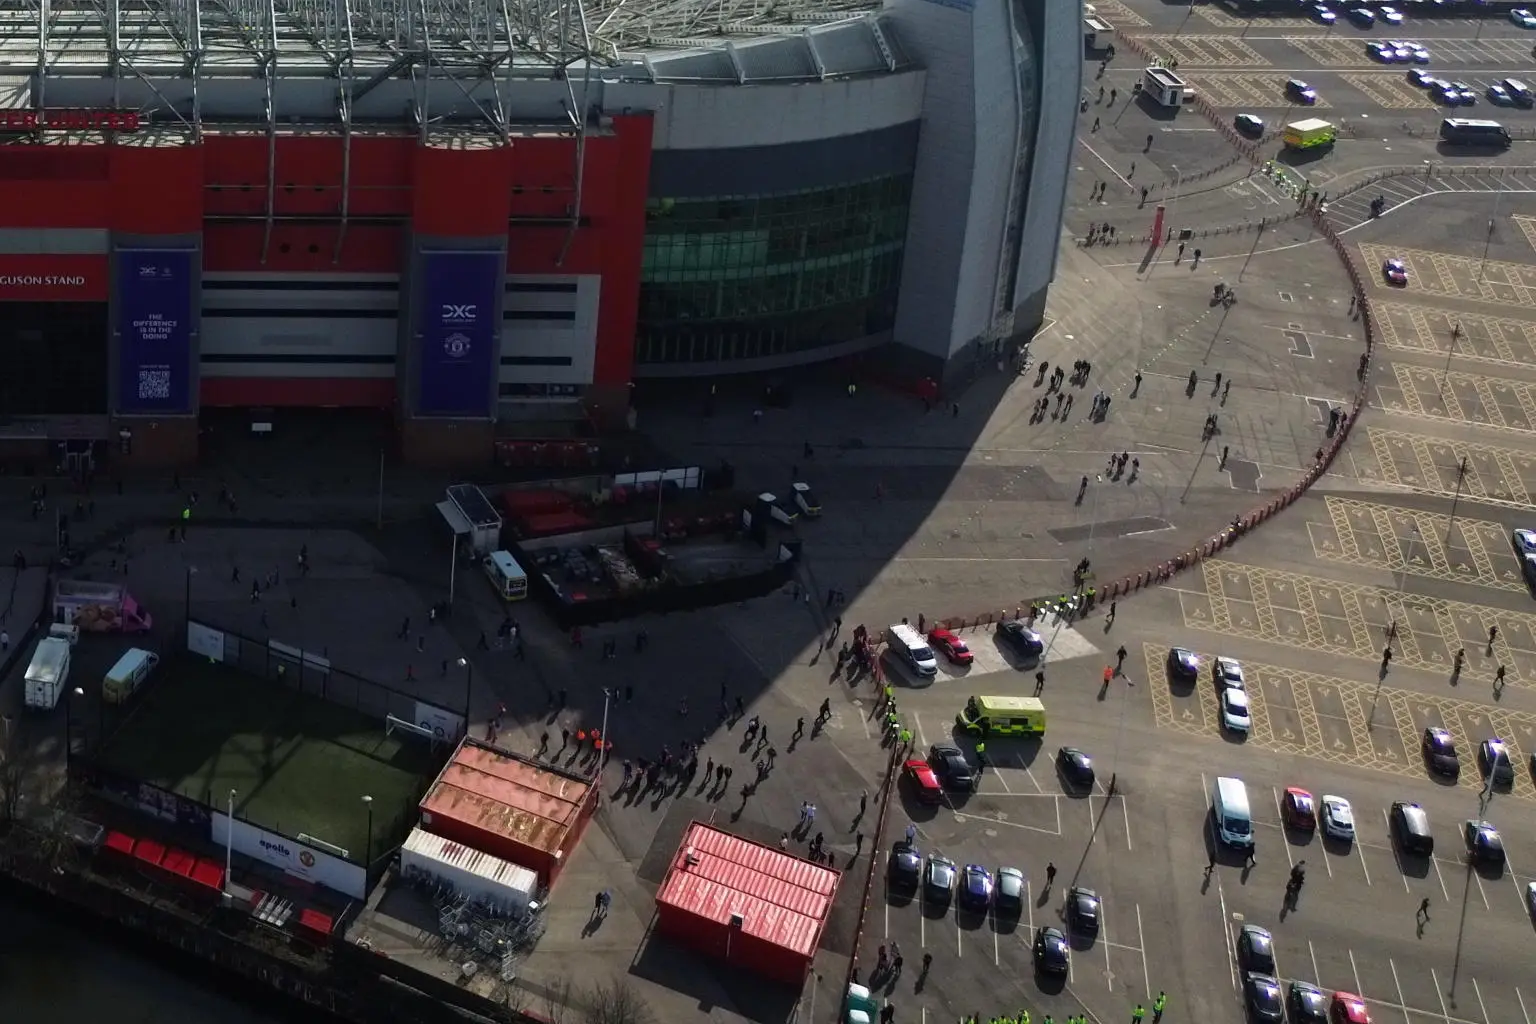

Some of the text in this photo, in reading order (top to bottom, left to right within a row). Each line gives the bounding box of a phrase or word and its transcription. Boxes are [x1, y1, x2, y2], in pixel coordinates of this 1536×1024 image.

[45, 275, 85, 285] STAND
[442, 304, 476, 318] DXC
[259, 839, 290, 856] apollo
